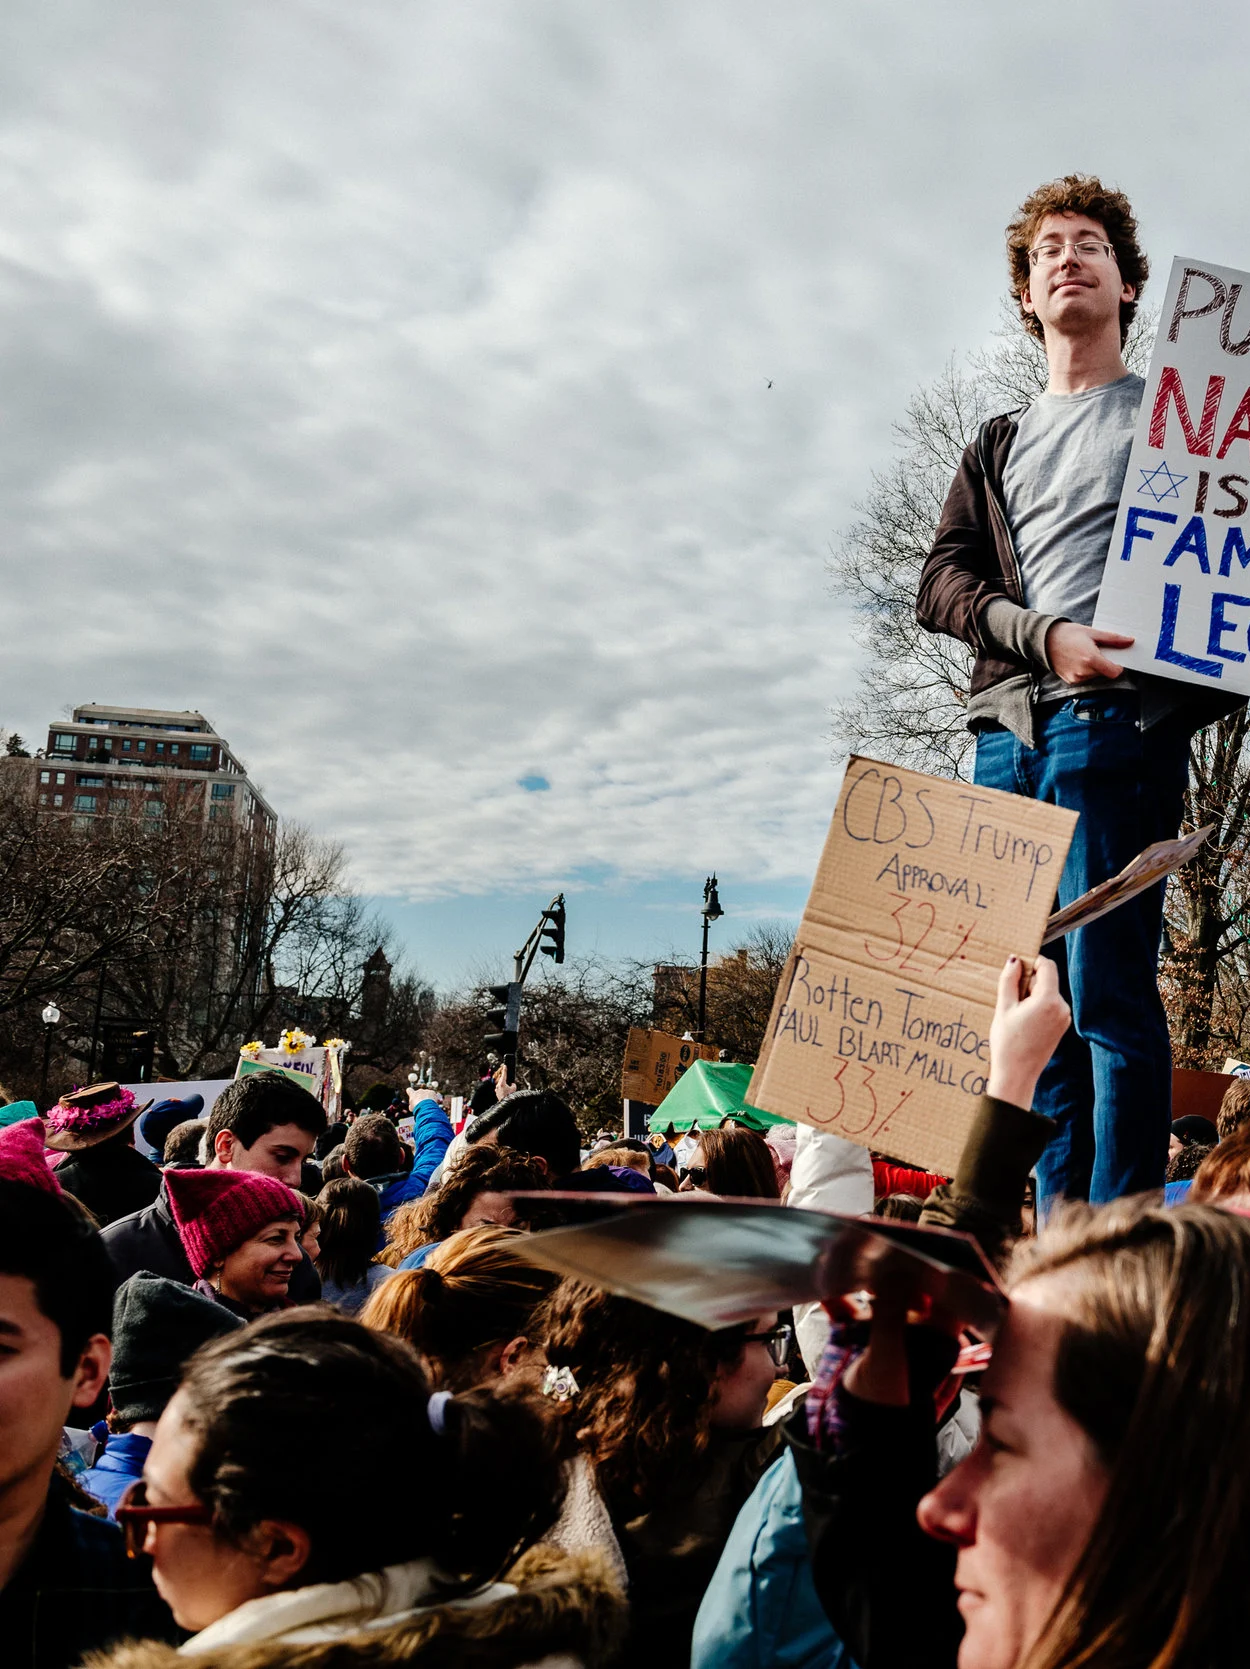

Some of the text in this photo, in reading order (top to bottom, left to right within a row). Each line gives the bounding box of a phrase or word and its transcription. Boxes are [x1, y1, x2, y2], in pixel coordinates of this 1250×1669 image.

[1194, 471, 1249, 519] IS
[844, 768, 1053, 902] CBS Trump
[864, 892, 978, 974] 32%
[774, 1004, 823, 1047] PAUL
[837, 1026, 906, 1067] BLART
[905, 1053, 958, 1087] MALL
[786, 955, 990, 1062] Rotten Tomatoe
[806, 1055, 914, 1137] 33%
